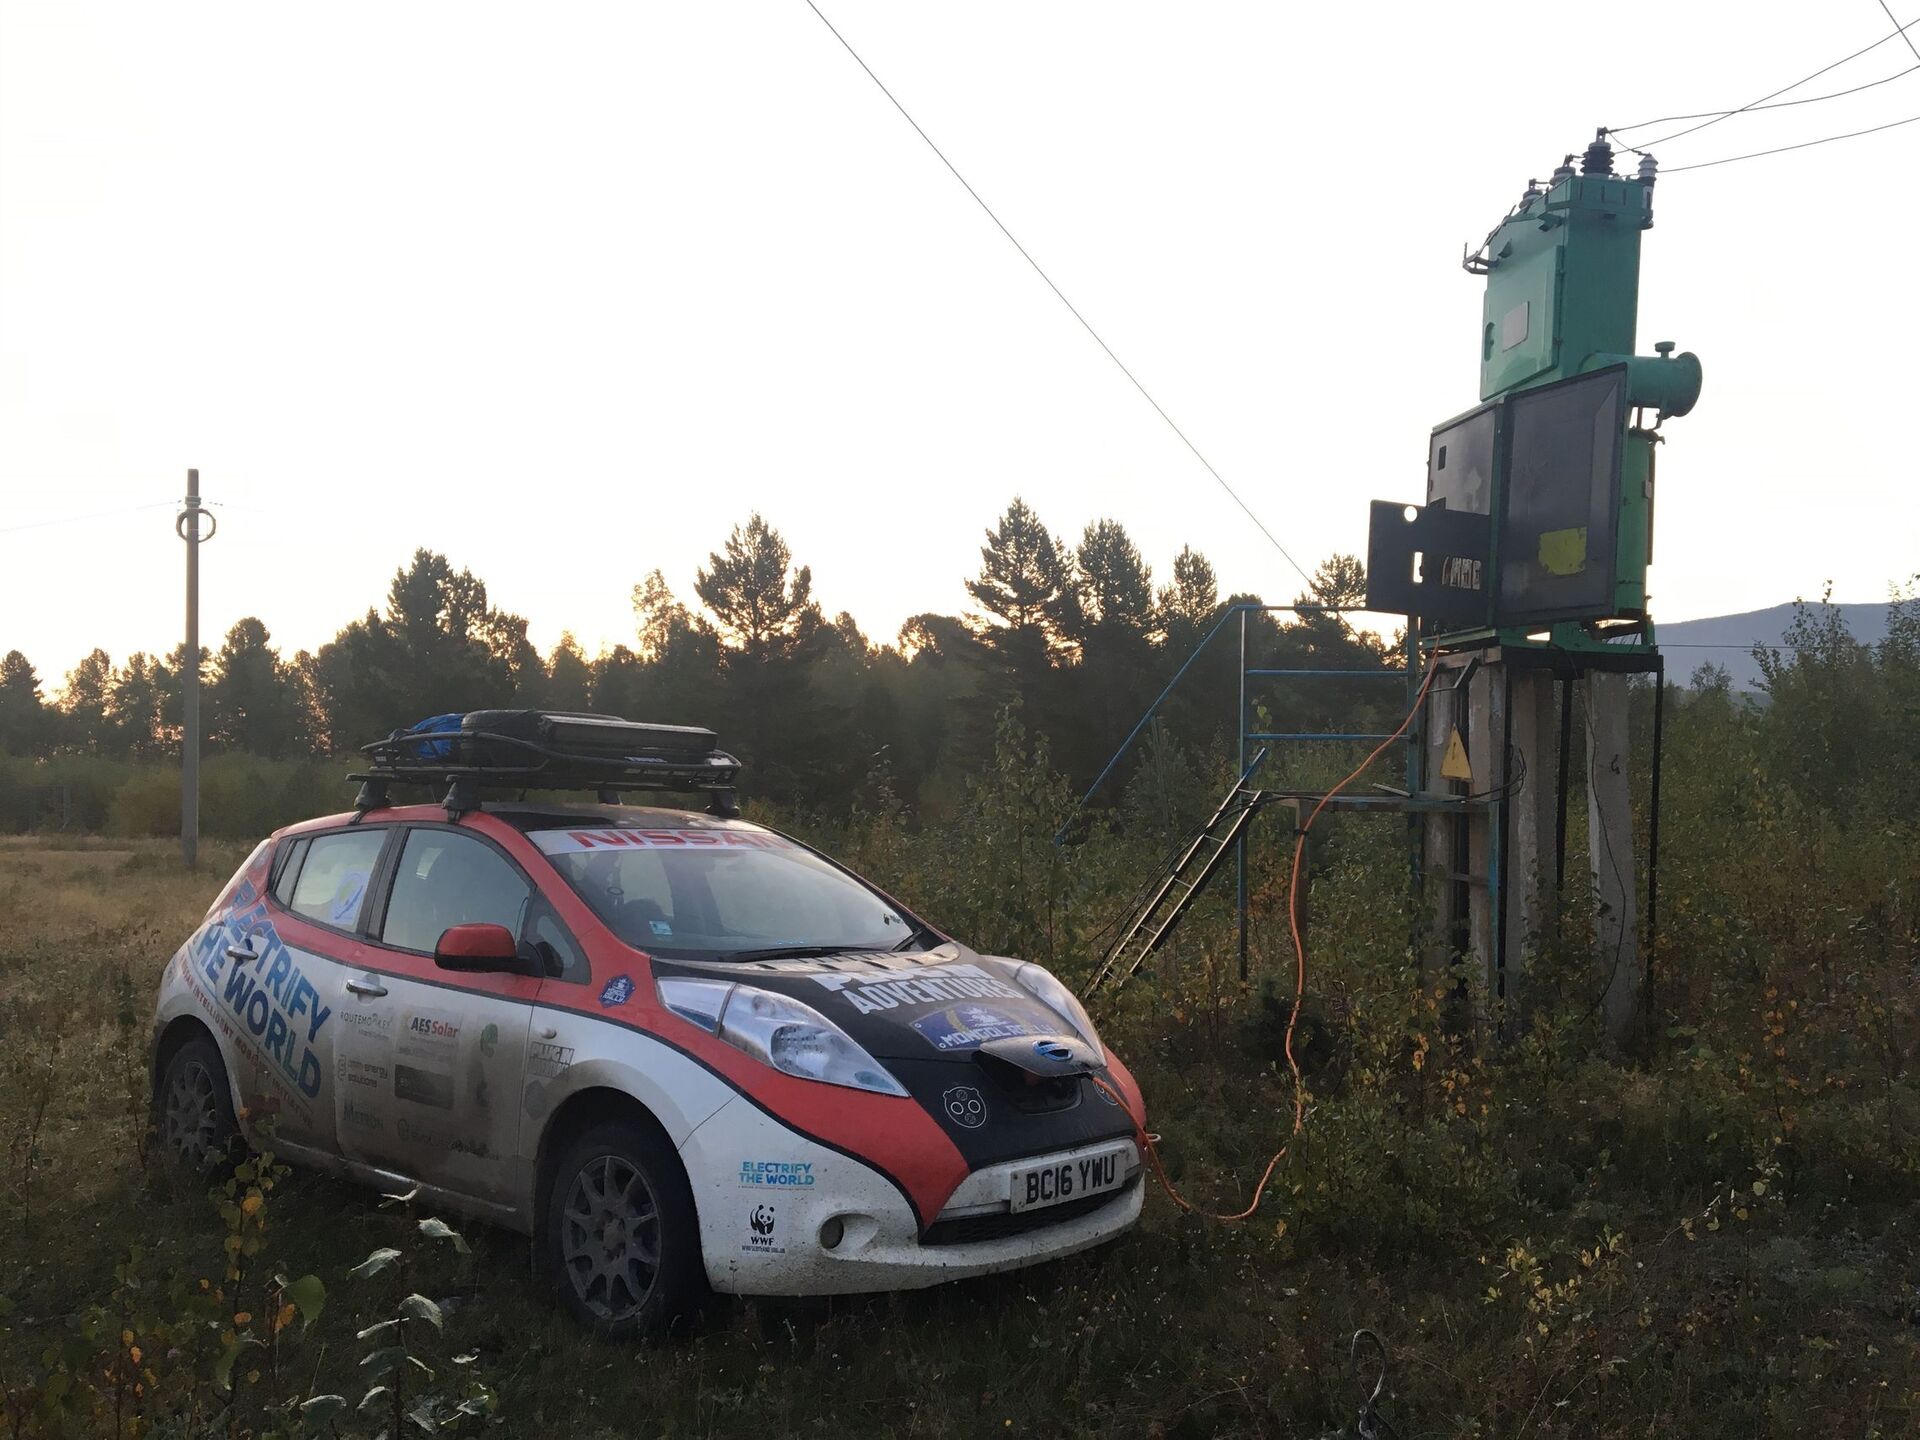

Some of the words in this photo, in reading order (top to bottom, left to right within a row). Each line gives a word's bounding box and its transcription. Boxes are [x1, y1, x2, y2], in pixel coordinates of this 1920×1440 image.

[568, 830, 793, 849] NISSAN
[841, 977, 1026, 1015] ADVENTURES
[223, 957, 322, 1099] WORLD
[940, 1025, 1011, 1048] MONGOL
[742, 1161, 813, 1174] ELECTRIFY
[739, 1172, 763, 1184] THE
[766, 1174, 815, 1186] WORLD
[1026, 1164, 1073, 1205] BC16
[1078, 1153, 1117, 1191] YWU
[750, 1236, 775, 1246] WWF
